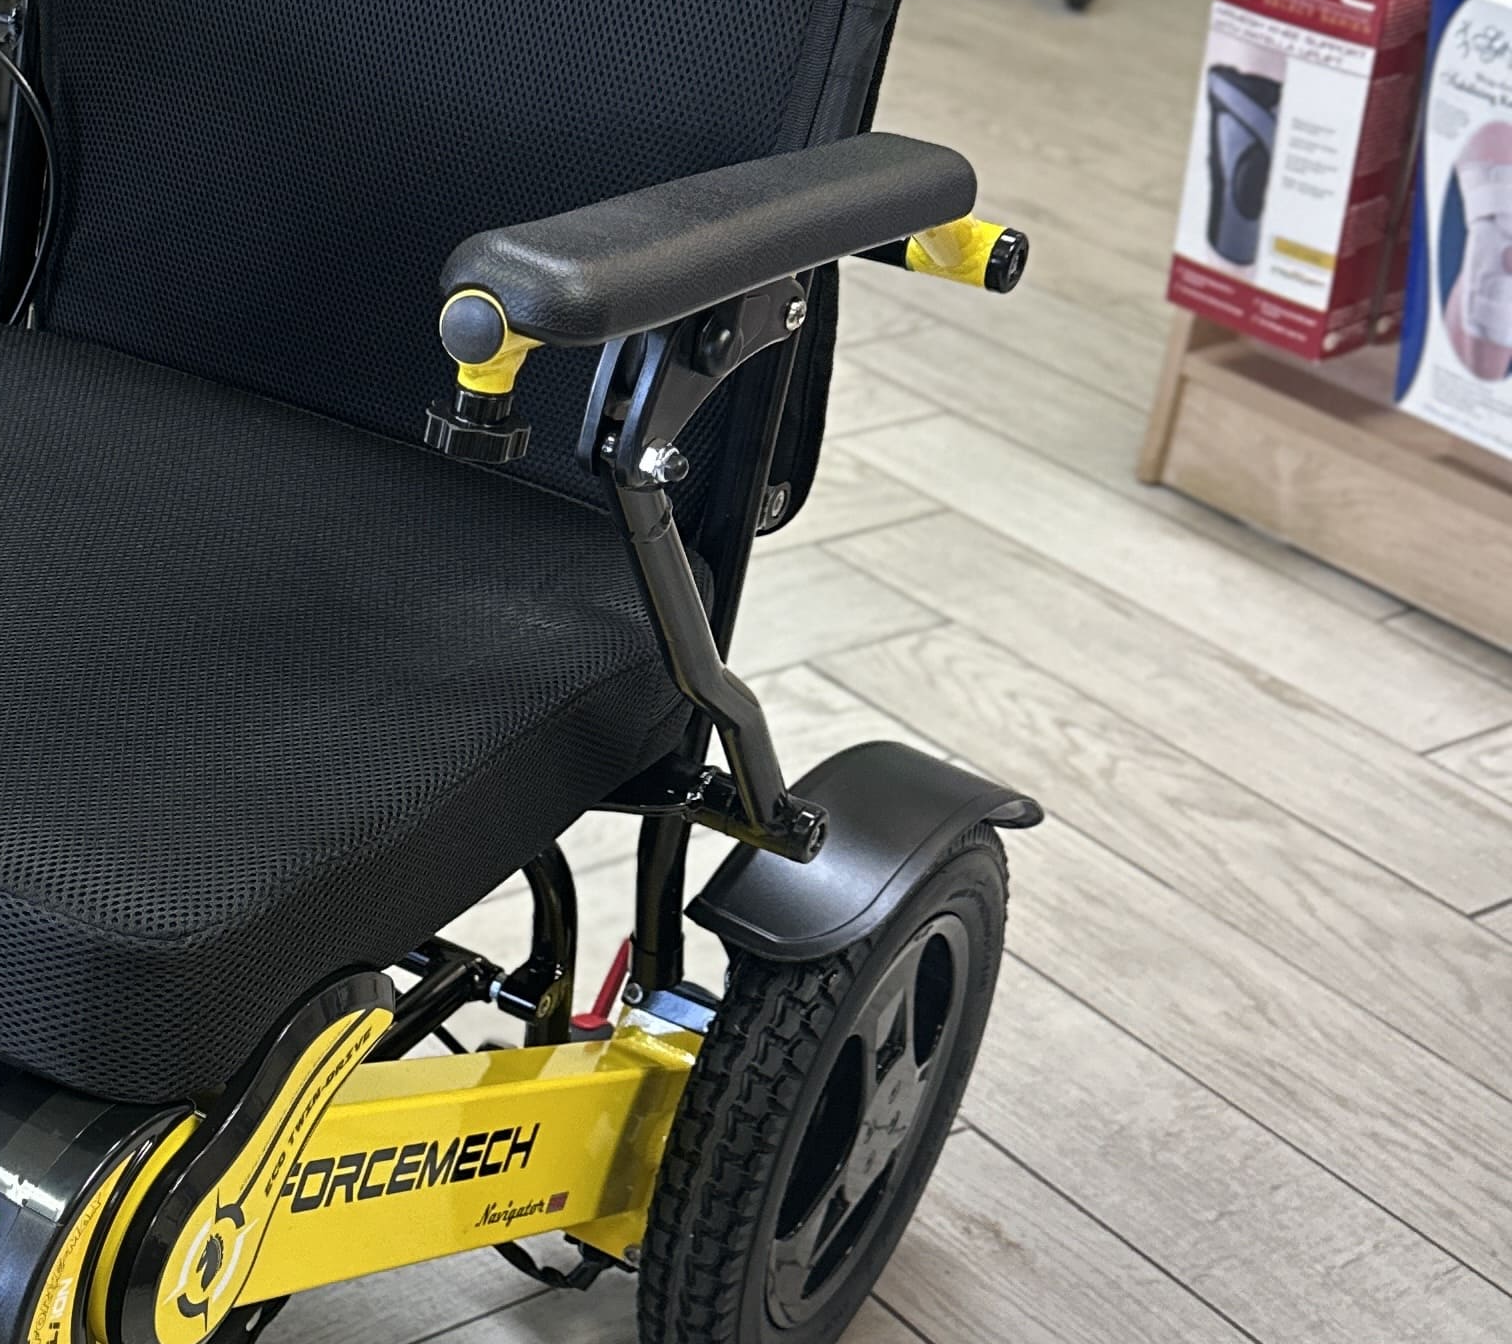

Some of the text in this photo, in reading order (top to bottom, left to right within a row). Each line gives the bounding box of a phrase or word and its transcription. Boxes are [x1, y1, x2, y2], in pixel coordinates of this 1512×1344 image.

[265, 1027, 373, 1197] ECO TWIN-DRIVE
[475, 1194, 547, 1228] Navigator
